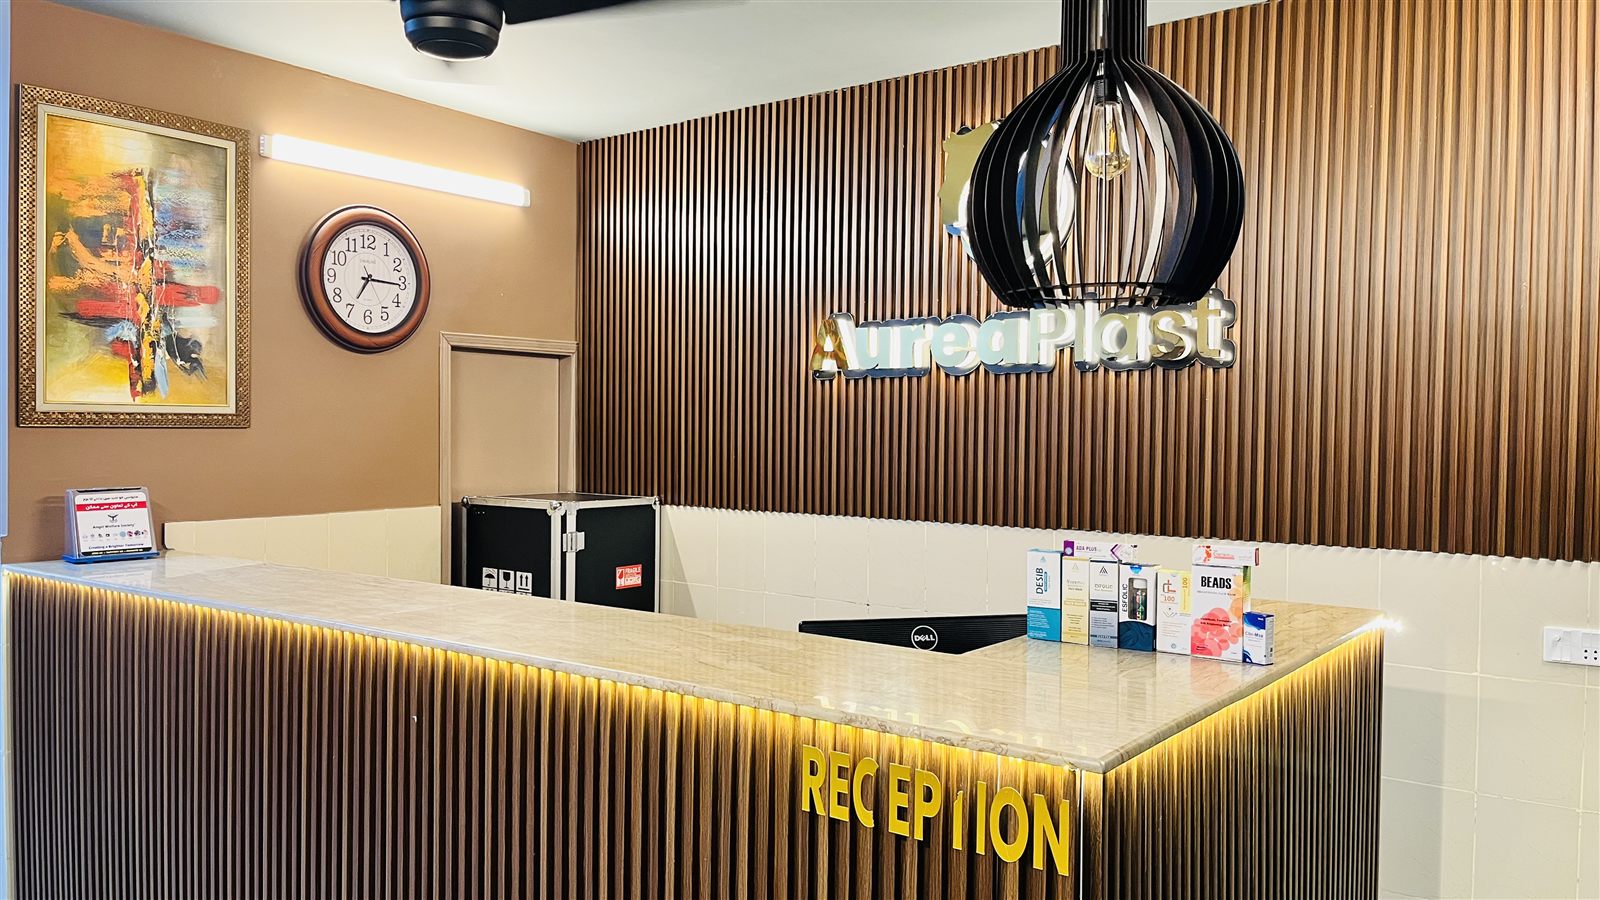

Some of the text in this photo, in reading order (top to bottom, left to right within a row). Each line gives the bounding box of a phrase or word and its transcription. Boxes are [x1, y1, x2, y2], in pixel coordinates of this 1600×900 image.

[345, 237, 357, 253] 11
[360, 234, 376, 250] 12
[383, 242, 389, 256] 1
[331, 250, 347, 266] 10
[393, 257, 402, 272] 2
[327, 268, 337, 283] 9
[398, 276, 407, 291] 3
[333, 287, 342, 303] 8
[392, 293, 401, 308] 4
[346, 304, 355, 318] 7
[363, 309, 373, 324] 6
[380, 306, 389, 321] 5
[809, 298, 1224, 374] AureaPlast
[1036, 567, 1044, 595] DESIB
[1200, 575, 1232, 590] BEADS
[914, 634, 935, 642] DELL
